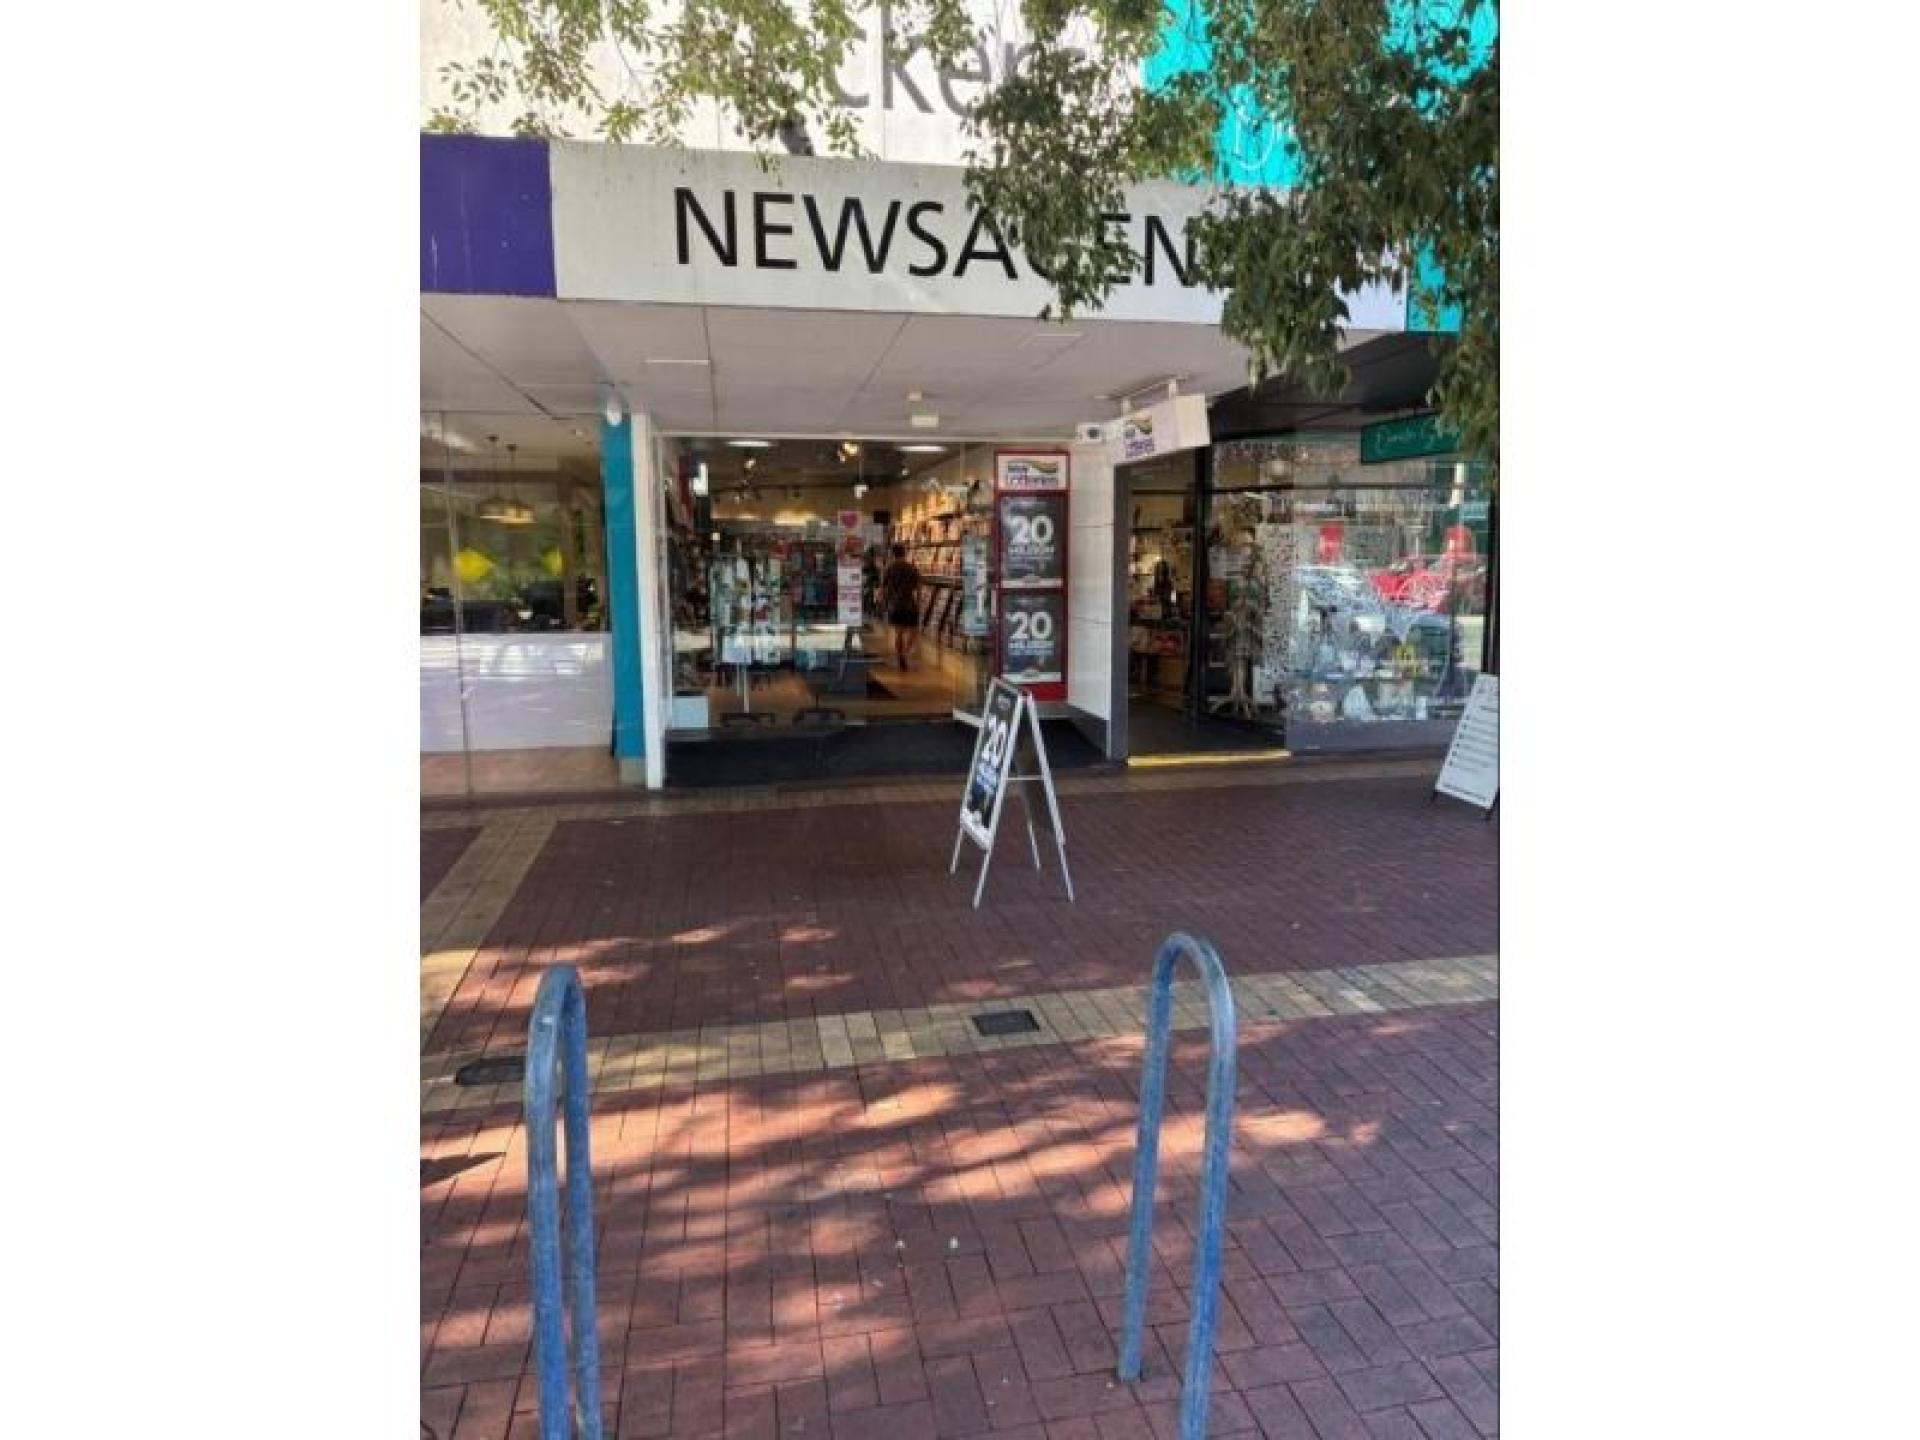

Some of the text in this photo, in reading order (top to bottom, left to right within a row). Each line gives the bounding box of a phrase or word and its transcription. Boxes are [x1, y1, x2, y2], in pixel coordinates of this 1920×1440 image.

[673, 186, 1199, 289] NEWSAEN
[1007, 515, 1054, 544] 20
[1006, 611, 1052, 639] 20
